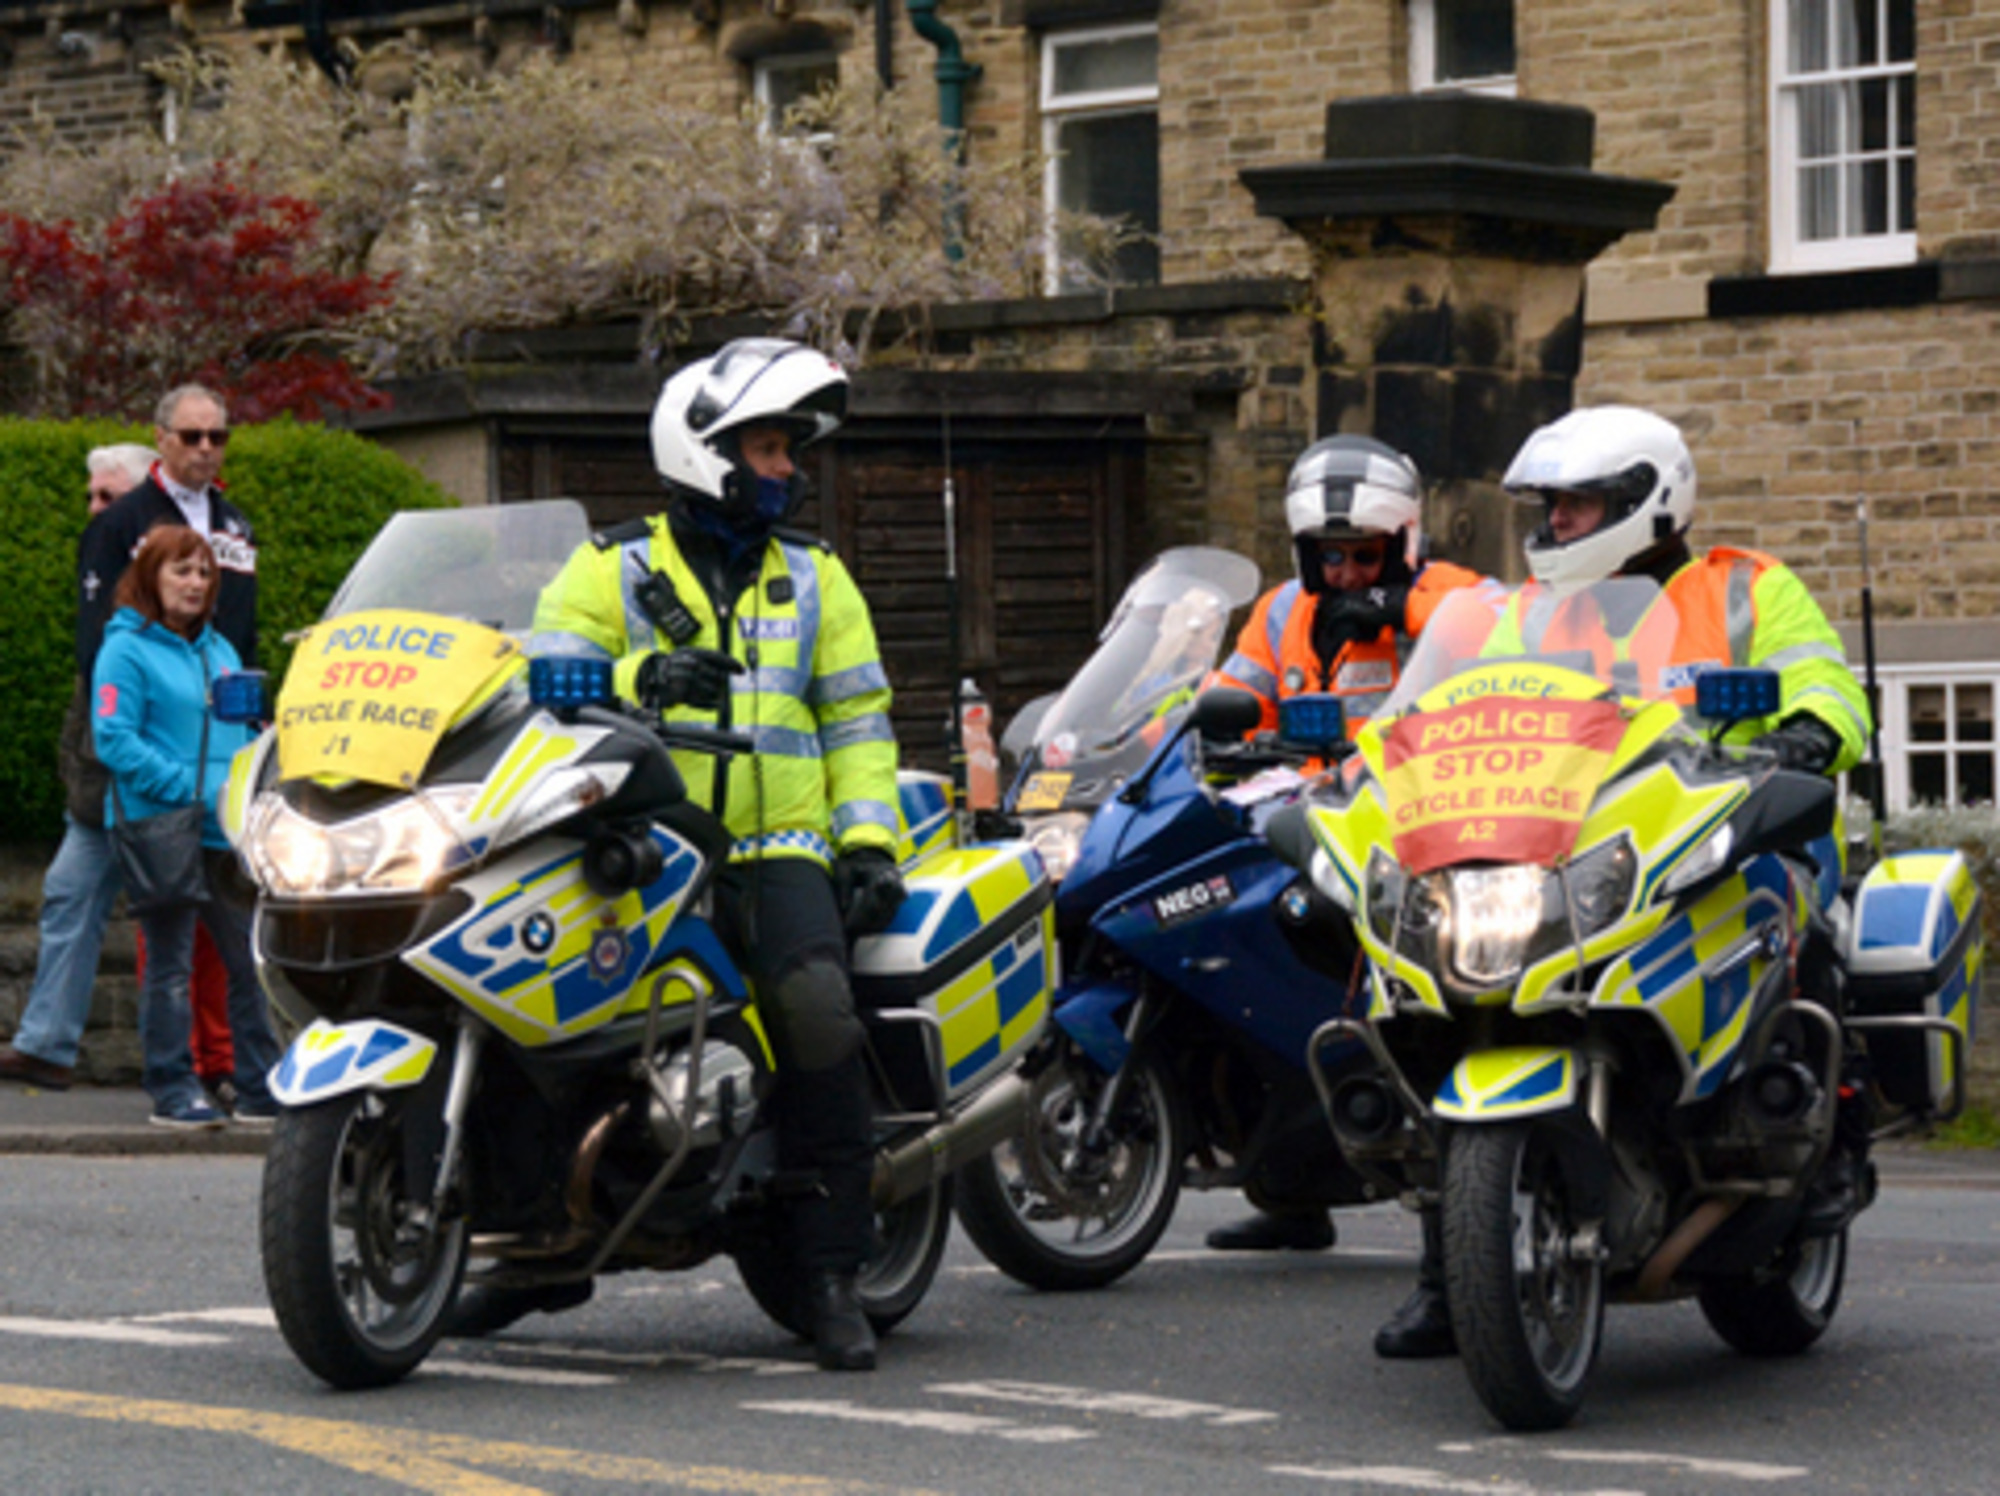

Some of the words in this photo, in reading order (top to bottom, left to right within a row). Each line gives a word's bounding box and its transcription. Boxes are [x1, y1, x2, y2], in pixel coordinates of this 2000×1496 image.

[322, 624, 457, 660] POLICE
[320, 661, 418, 690] STOP
[1446, 674, 1564, 706] POLICE
[282, 699, 354, 729] CYCLE
[359, 699, 439, 732] RACE
[1420, 708, 1572, 750] POLICE
[1433, 748, 1544, 782] STOP
[1395, 786, 1487, 826] CYCLE
[1495, 785, 1581, 814] RACE
[1457, 819, 1498, 844] A2
[1157, 882, 1211, 919] NEG
